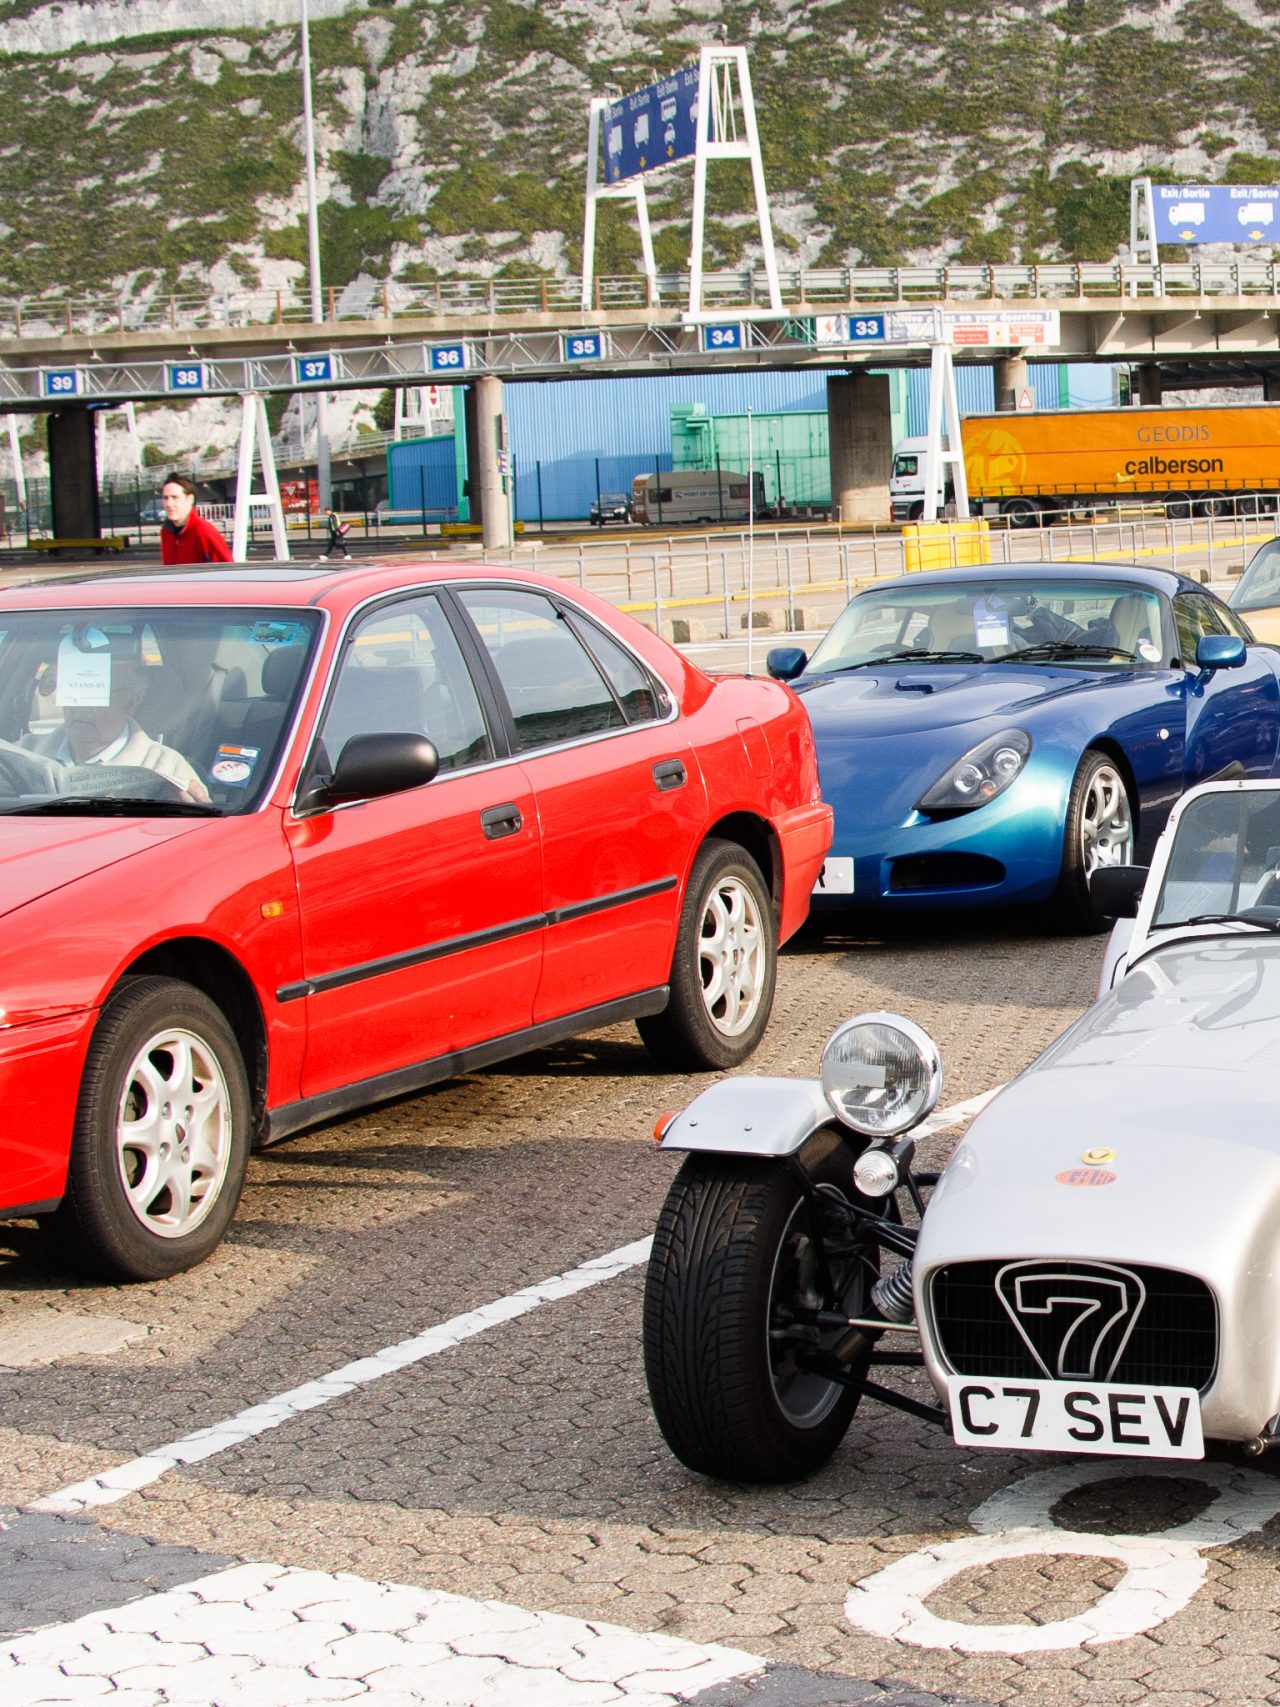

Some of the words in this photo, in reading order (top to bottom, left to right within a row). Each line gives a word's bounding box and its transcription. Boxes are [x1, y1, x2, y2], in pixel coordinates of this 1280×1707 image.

[855, 320, 880, 336] 33
[711, 329, 735, 346] 34
[571, 340, 596, 356] 35
[437, 350, 460, 367] 36
[305, 360, 326, 378] 37
[51, 375, 74, 391] 39
[176, 370, 200, 386] 38
[1136, 424, 1210, 443] GEODIS
[1125, 456, 1224, 476] calberson
[1015, 1273, 1128, 1379] 7
[958, 1385, 1041, 1438] C7
[1063, 1390, 1191, 1447] SEV
